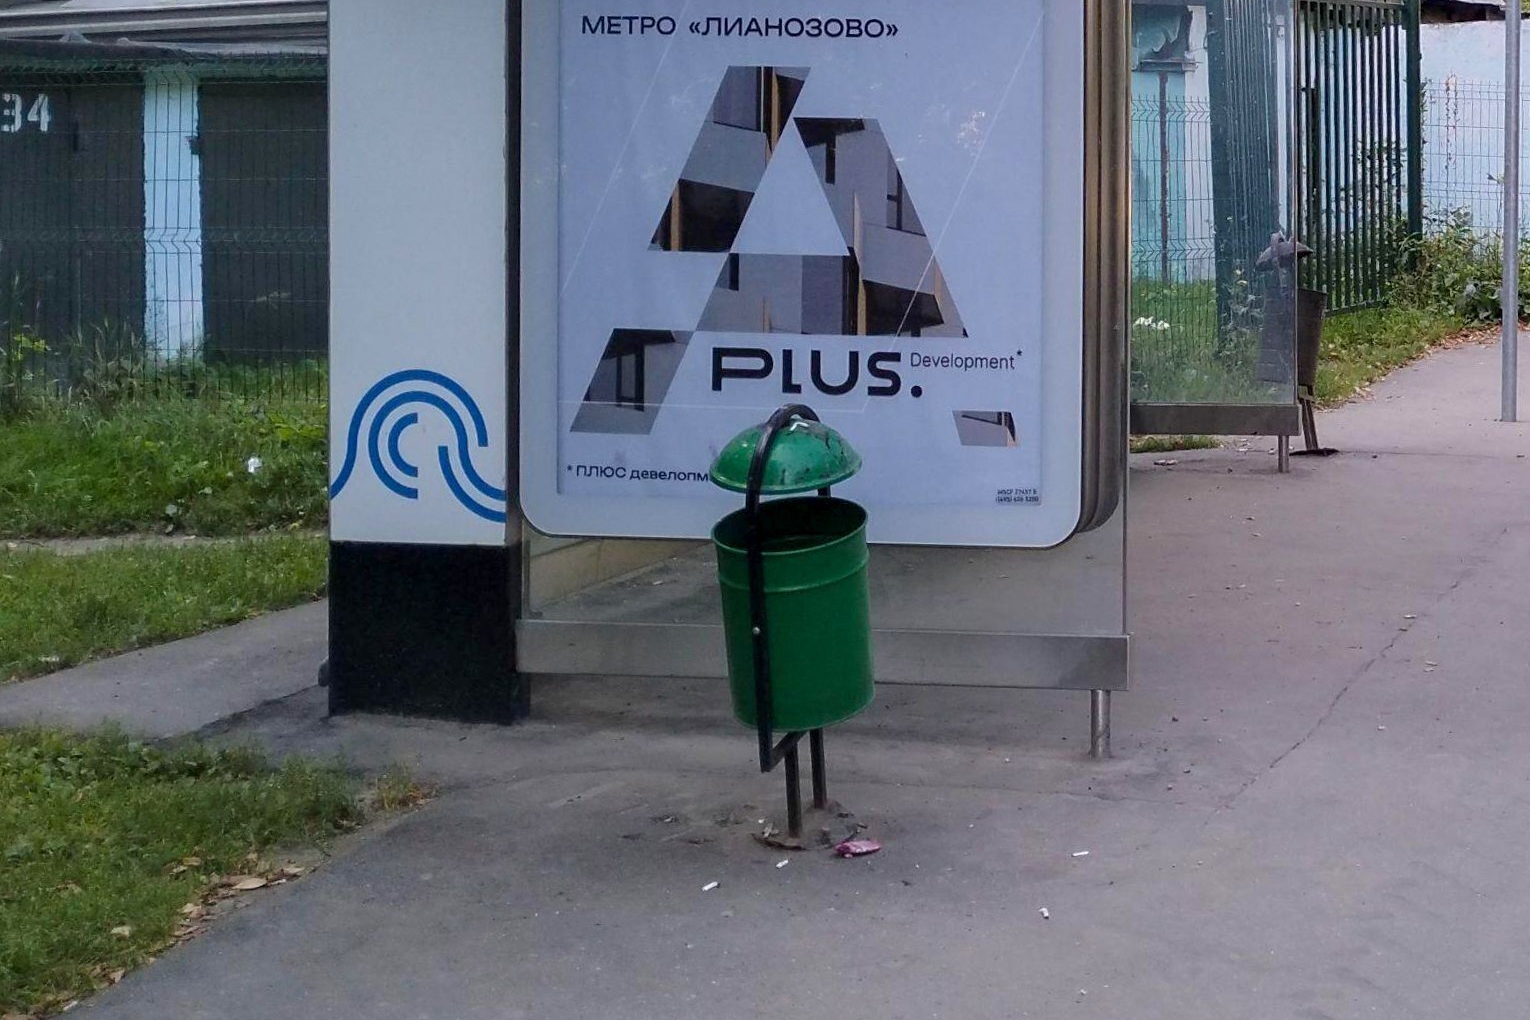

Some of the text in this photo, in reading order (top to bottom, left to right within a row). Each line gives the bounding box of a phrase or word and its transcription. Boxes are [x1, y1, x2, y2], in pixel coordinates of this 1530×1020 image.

[581, 16, 900, 38] МЕТРО «ЛИАНОЗОВО»
[576, 464, 710, 482] ПЛЮС девелопм
